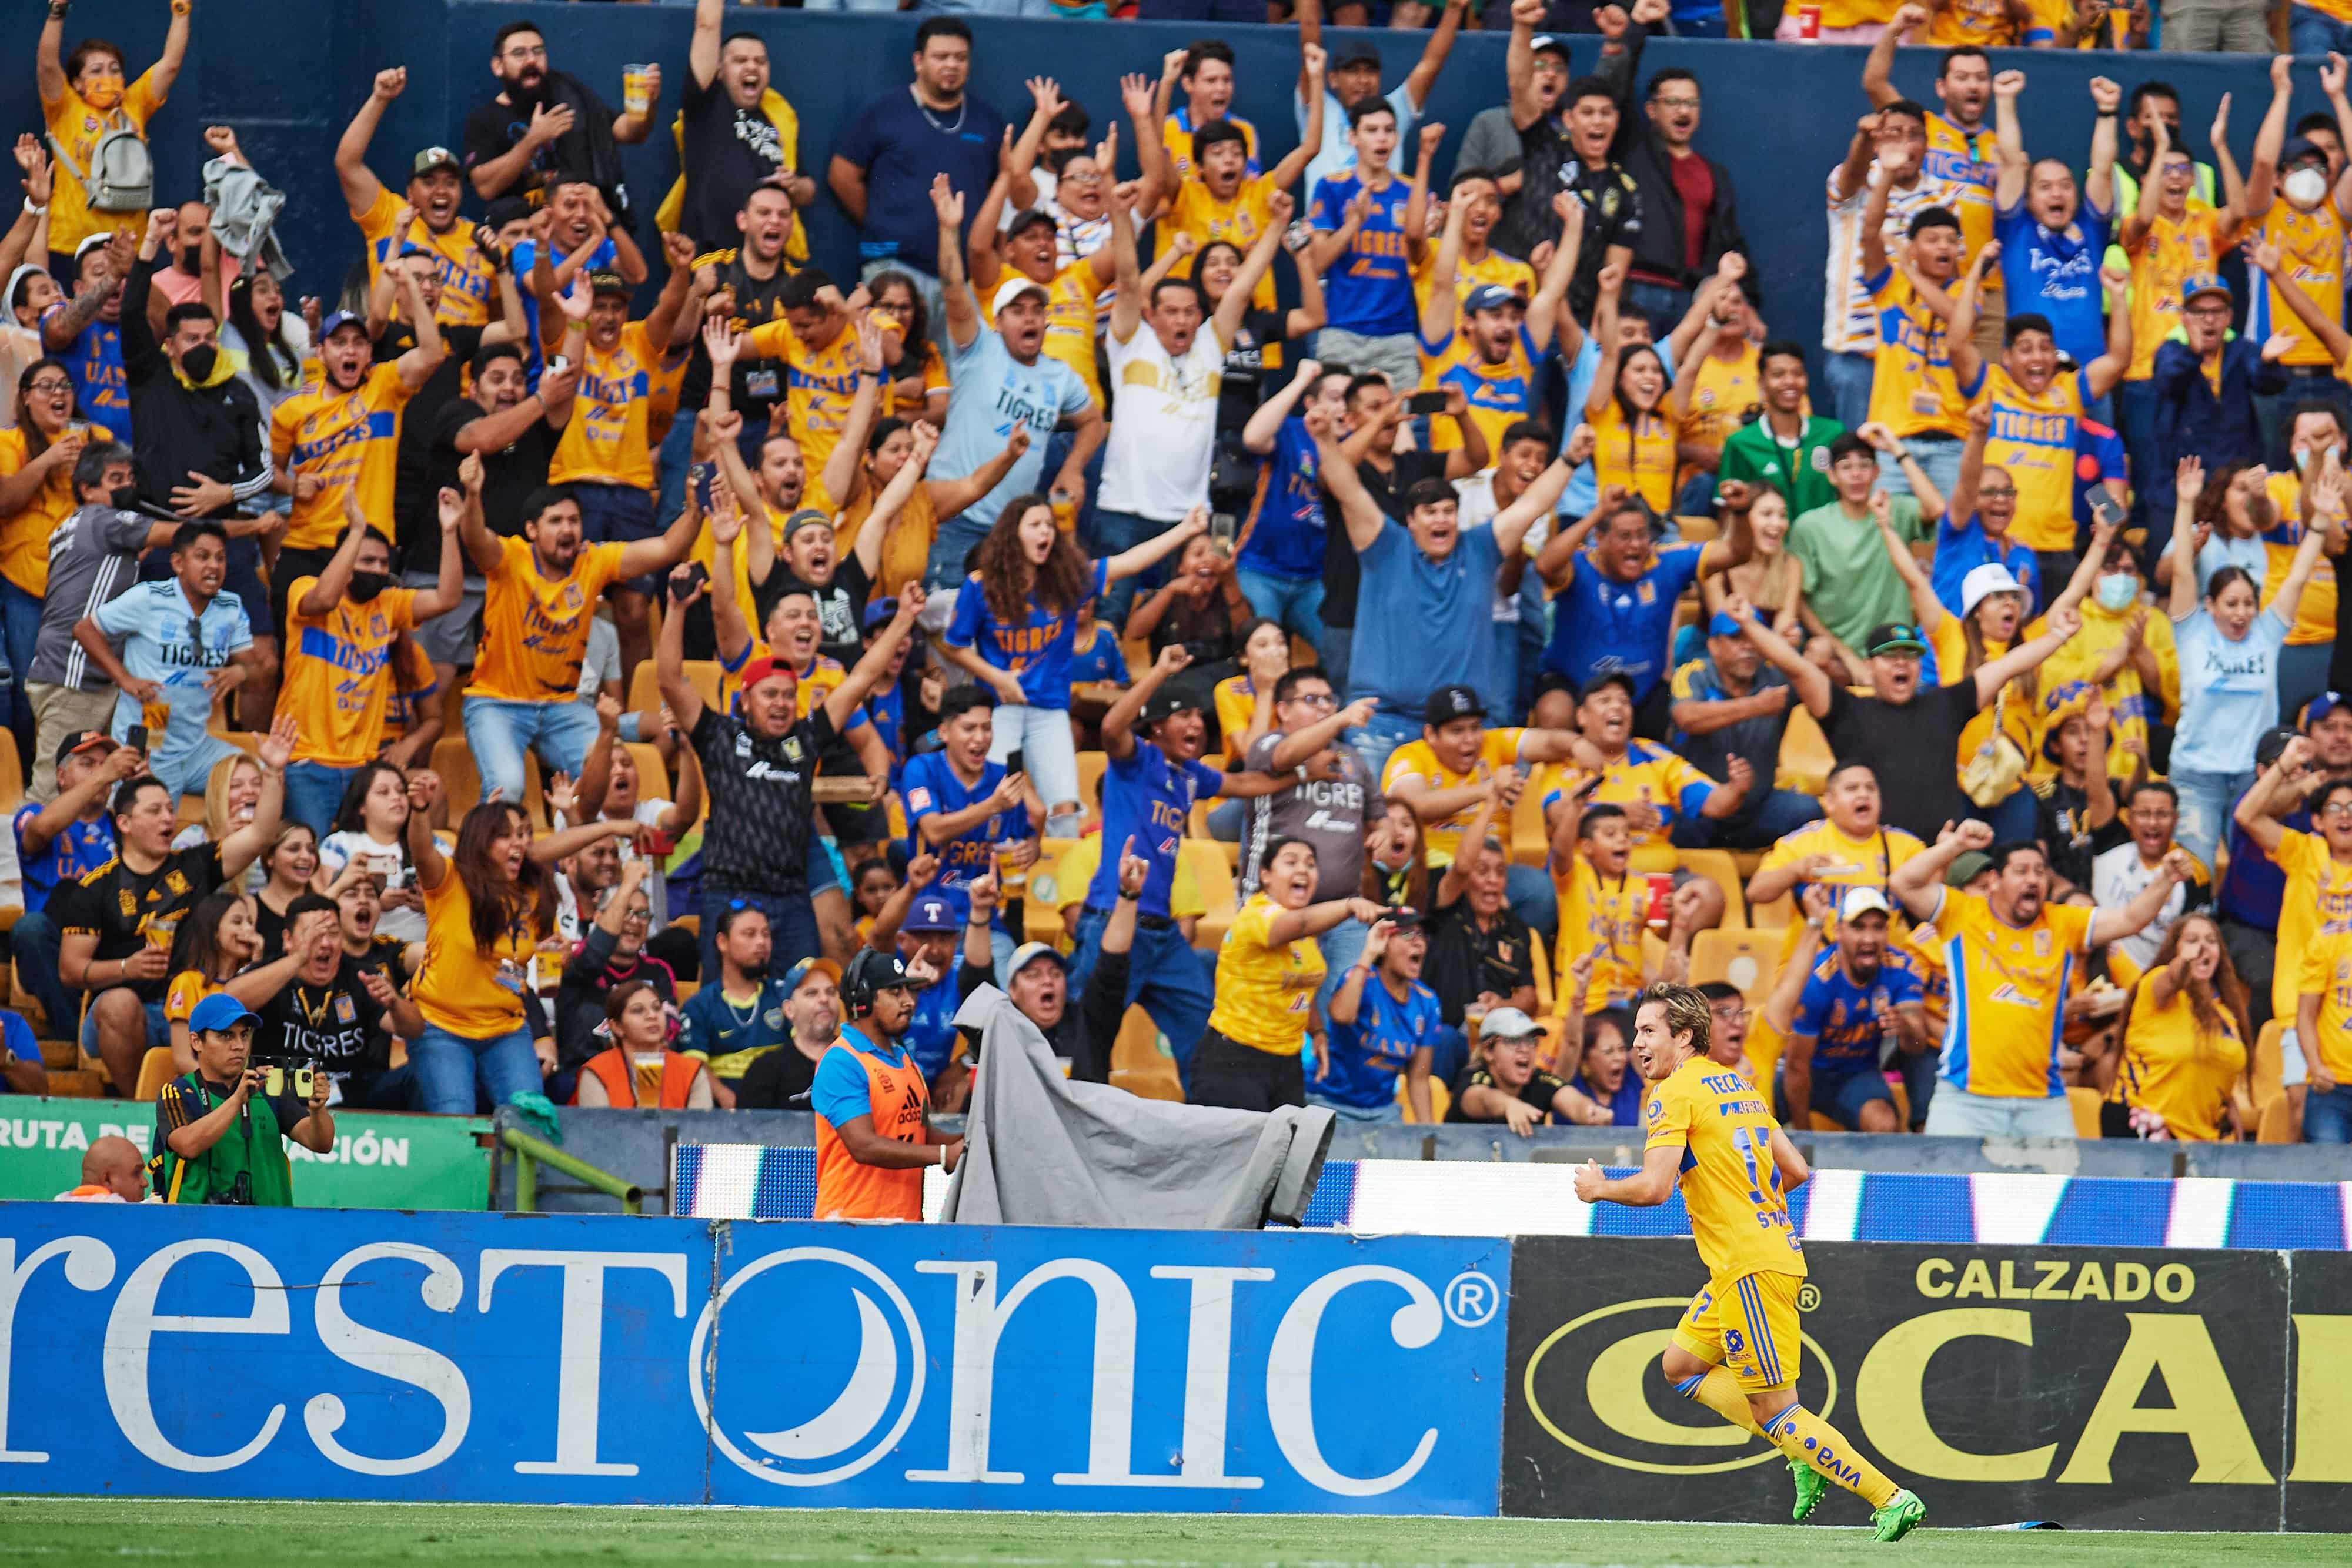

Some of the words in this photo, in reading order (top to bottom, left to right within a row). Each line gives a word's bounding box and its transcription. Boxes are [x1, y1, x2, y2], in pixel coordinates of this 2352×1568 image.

[86, 362, 126, 389] UAN
[994, 389, 1057, 436] TIGRES
[1151, 800, 1184, 833] TIG
[57, 858, 89, 879] UA
[282, 1021, 365, 1059] TIGRES
[1916, 1258, 2196, 1303] CALZADO
